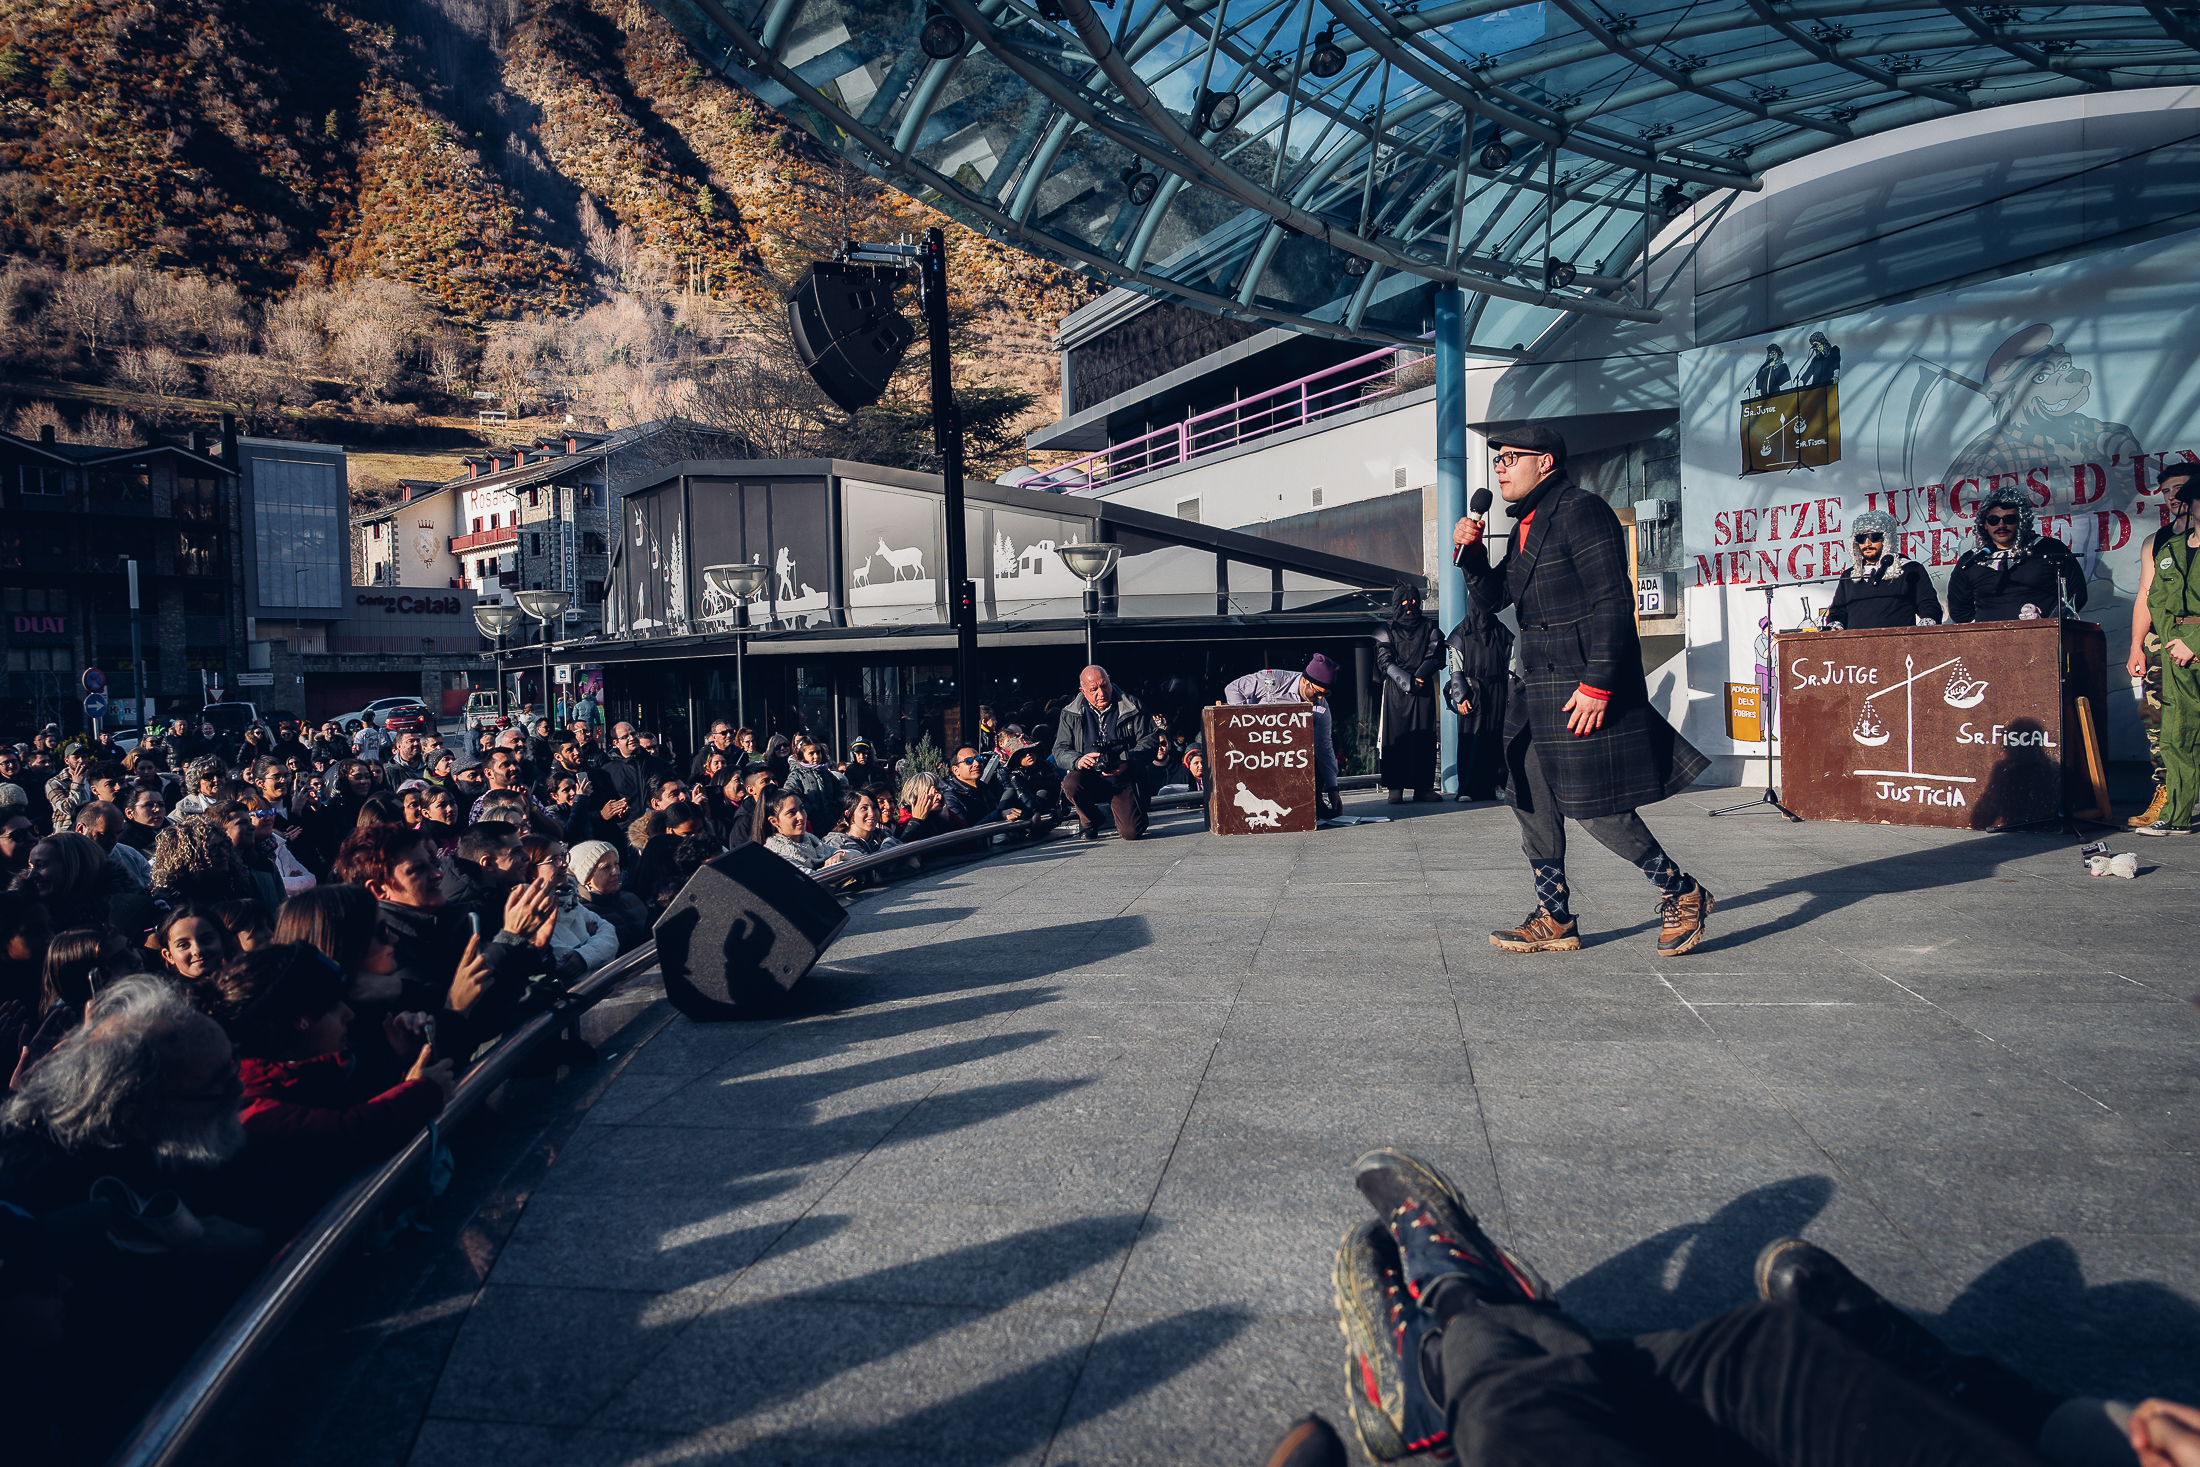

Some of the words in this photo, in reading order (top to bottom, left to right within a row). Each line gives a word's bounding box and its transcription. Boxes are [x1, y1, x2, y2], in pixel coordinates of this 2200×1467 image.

[1714, 496, 1843, 547] SETZE
[2070, 449, 2200, 506] D'U
[563, 489, 572, 542] HOTEL
[397, 595, 462, 615] Català
[14, 616, 68, 634] DUAT
[1731, 685, 1760, 695] ADVOCAT
[1738, 697, 1755, 706] DELS
[1228, 712, 1313, 728] ADVOCAT
[1248, 729, 1293, 745] DELS
